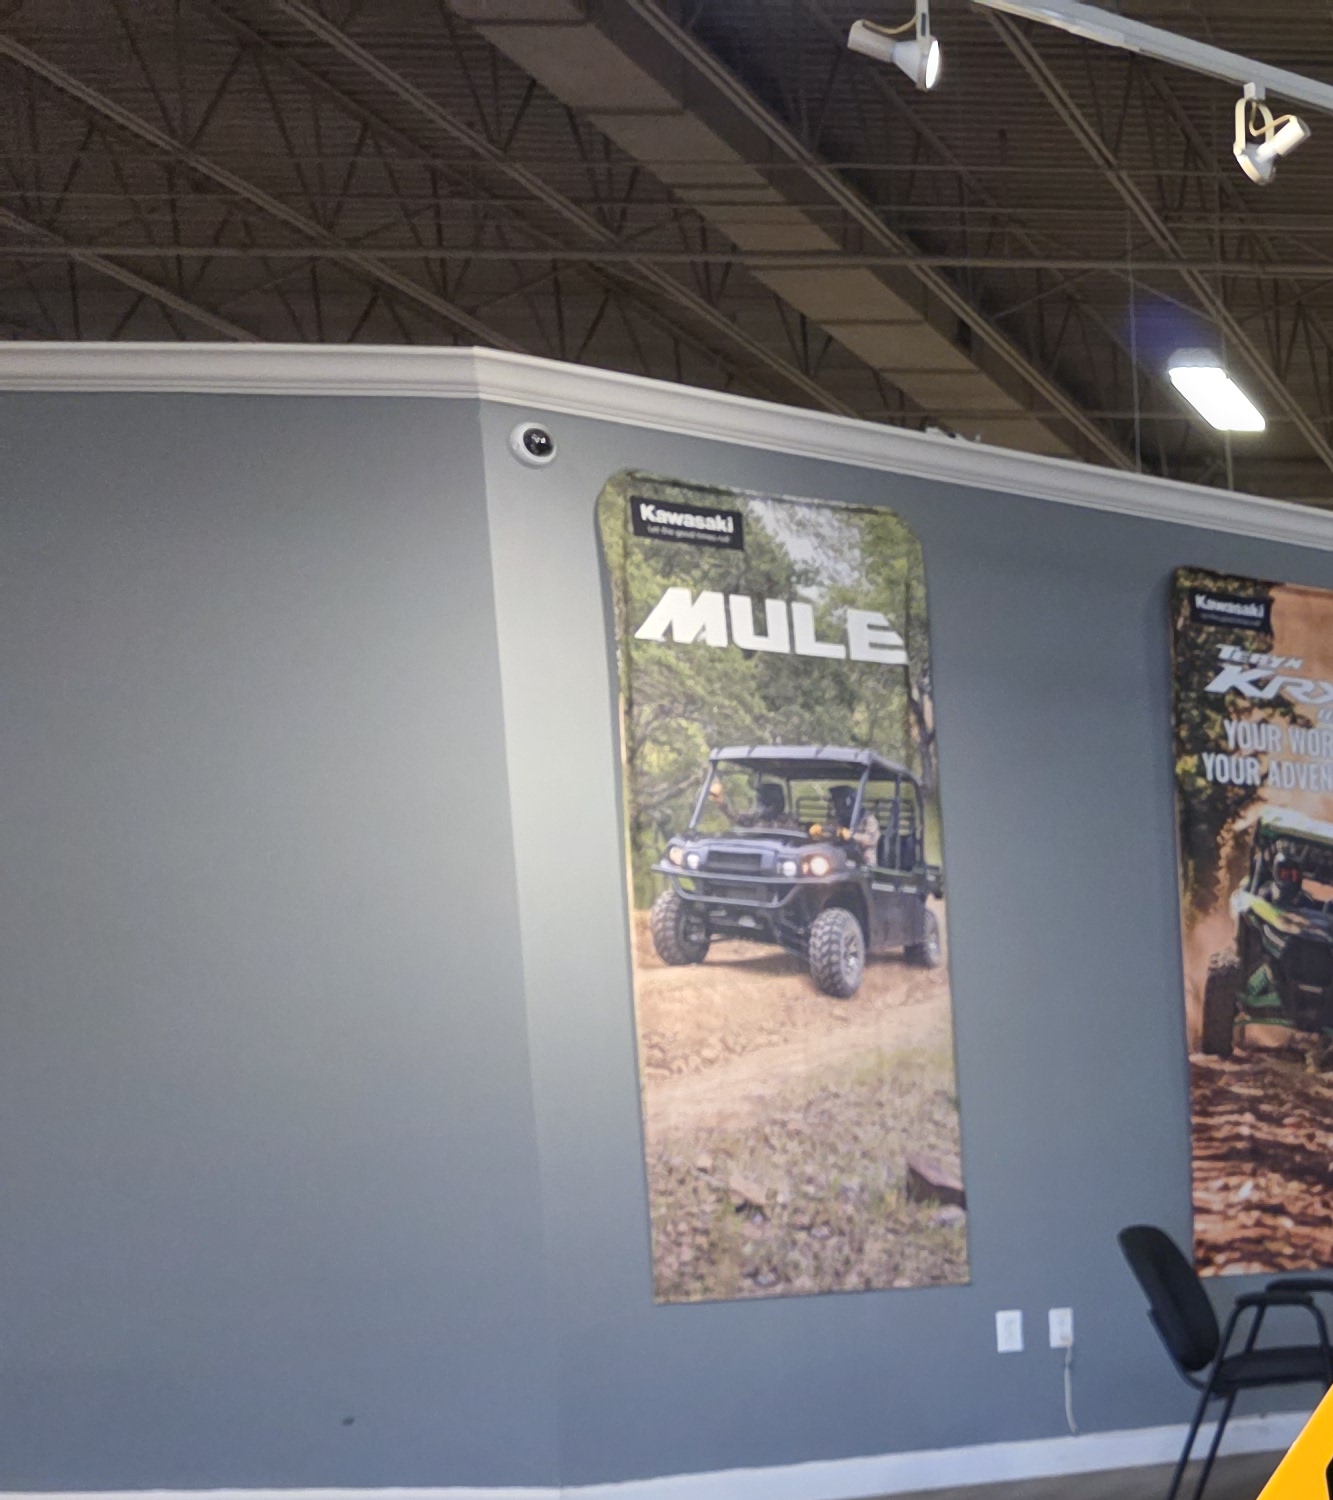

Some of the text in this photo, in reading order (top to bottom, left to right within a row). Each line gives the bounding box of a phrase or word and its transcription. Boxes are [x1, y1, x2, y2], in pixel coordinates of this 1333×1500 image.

[640, 502, 735, 534] Kawasaki
[1194, 594, 1265, 618] Kawasaki
[634, 586, 909, 666] MULE
[1224, 718, 1282, 752] YOUR
[1202, 752, 1261, 786] YOUR
